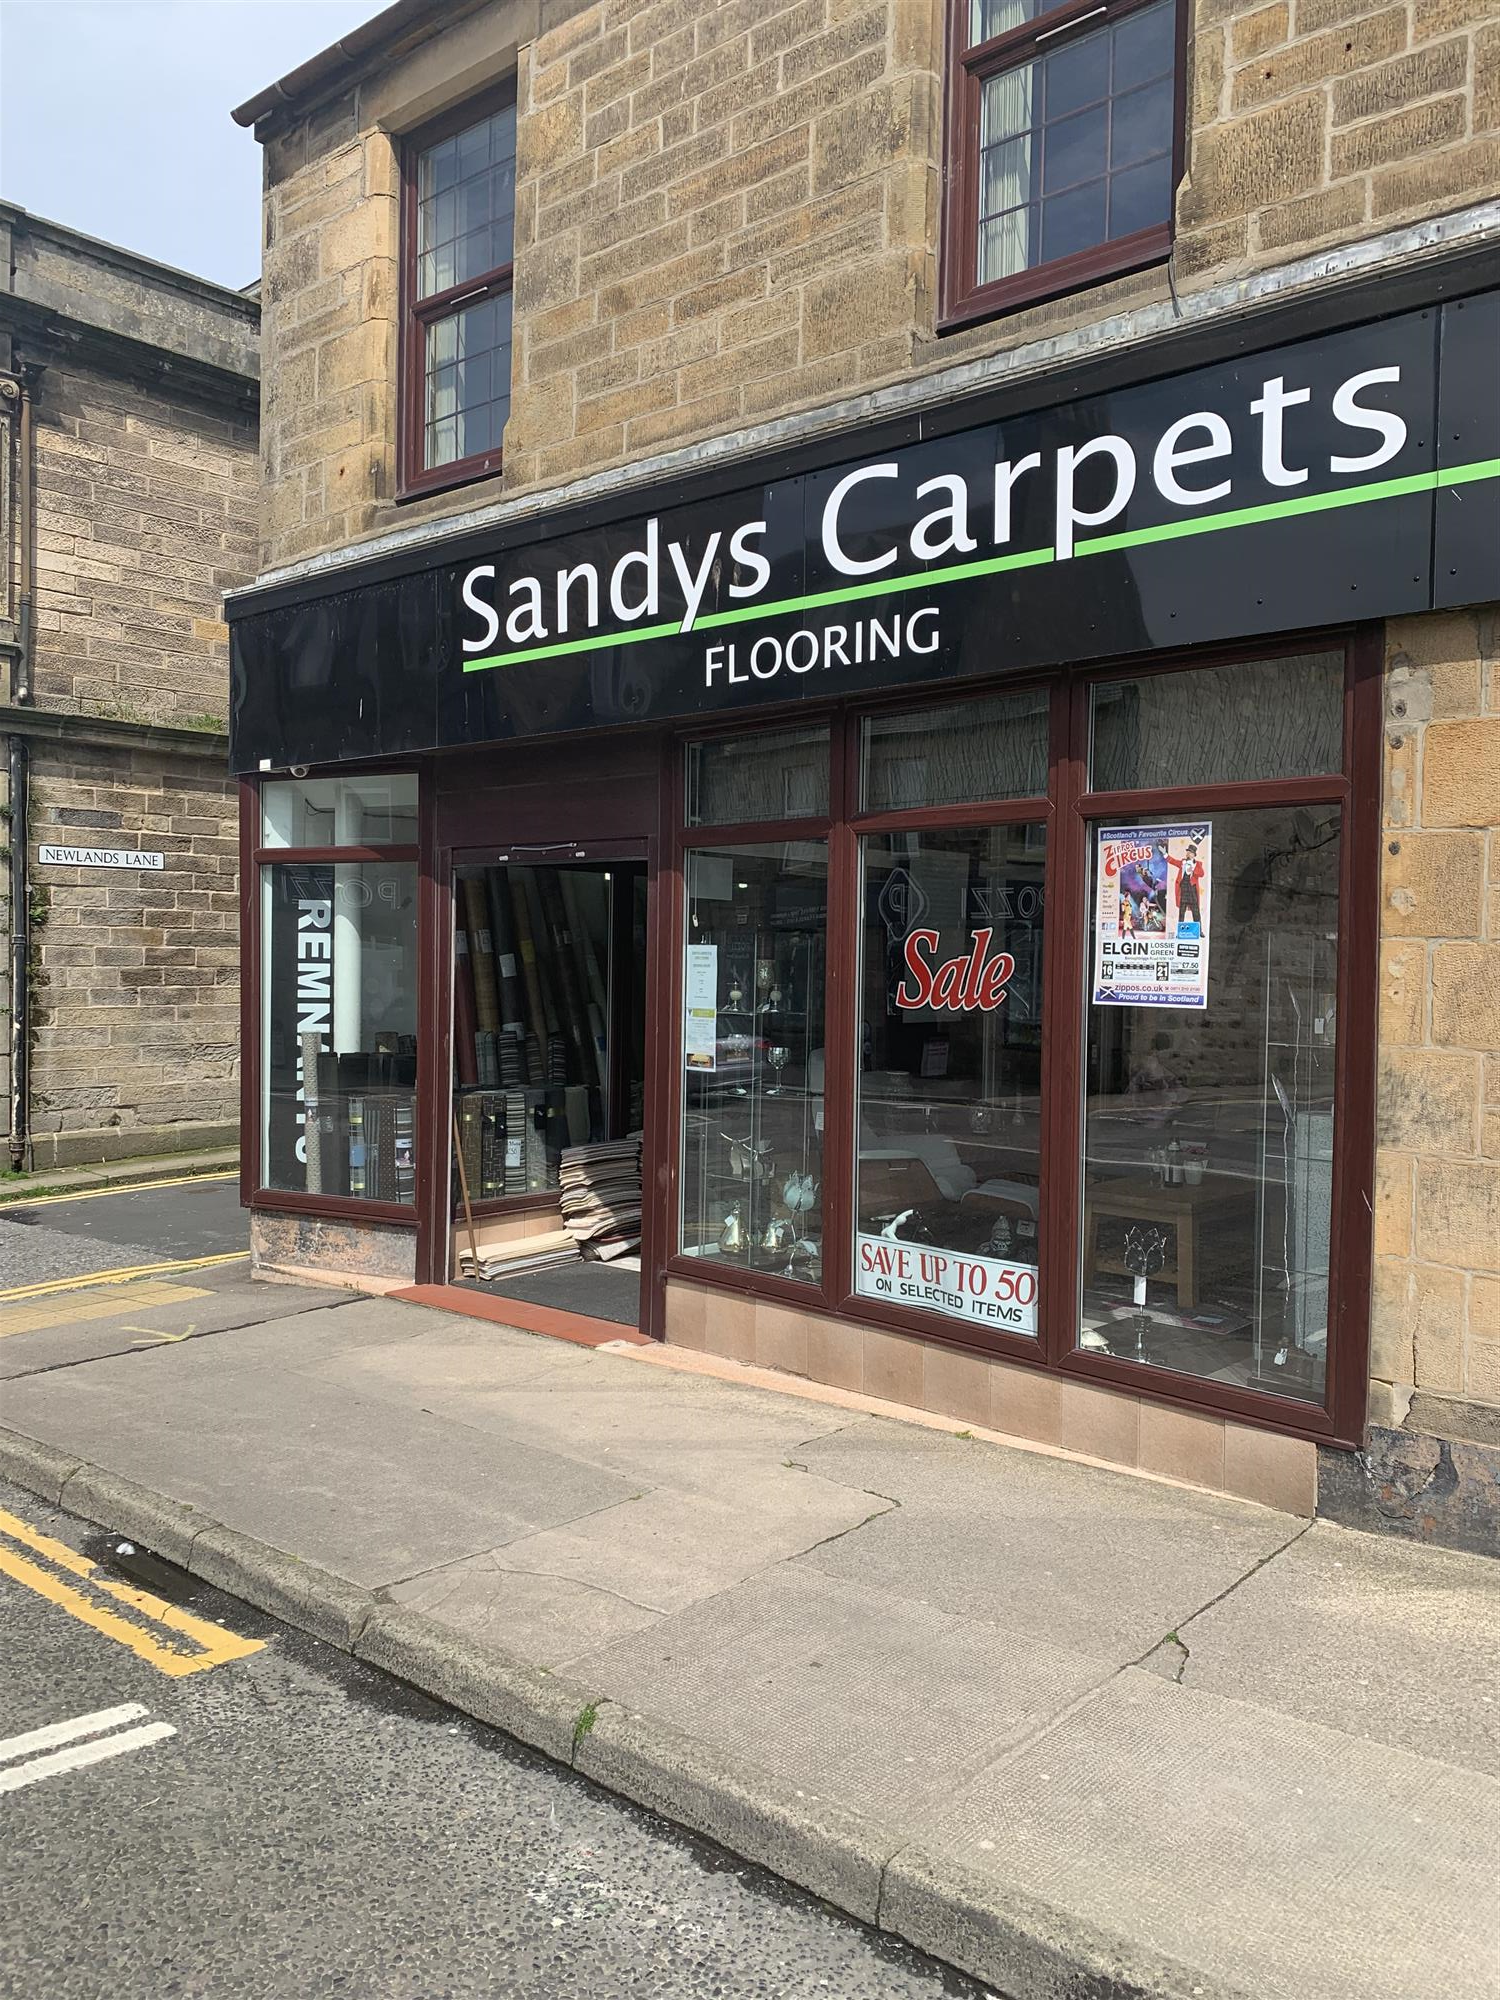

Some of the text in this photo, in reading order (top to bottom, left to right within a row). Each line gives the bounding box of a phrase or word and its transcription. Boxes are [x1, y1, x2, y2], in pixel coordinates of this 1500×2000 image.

[462, 365, 1408, 653] Sandys Carpets
[705, 606, 940, 687] FLOORING
[1139, 829, 1166, 838] Favourite
[1168, 828, 1188, 837] Circus
[45, 848, 159, 867] NEWLANDS LANE
[1104, 845, 1152, 877] CIRCUS
[1102, 942, 1149, 956] ELGIN
[895, 926, 1016, 1012] Sale
[1102, 965, 1113, 975] 16
[1157, 966, 1168, 976] 21
[1114, 984, 1164, 992] zippos.co.uk
[1118, 993, 1139, 1001] Proud
[1167, 995, 1200, 1003] Scotland
[861, 1243, 913, 1280] SAVE
[919, 1253, 948, 1286] UP
[953, 1260, 988, 1296] TO
[875, 1277, 1023, 1323] ON SELECTED ITEMS
